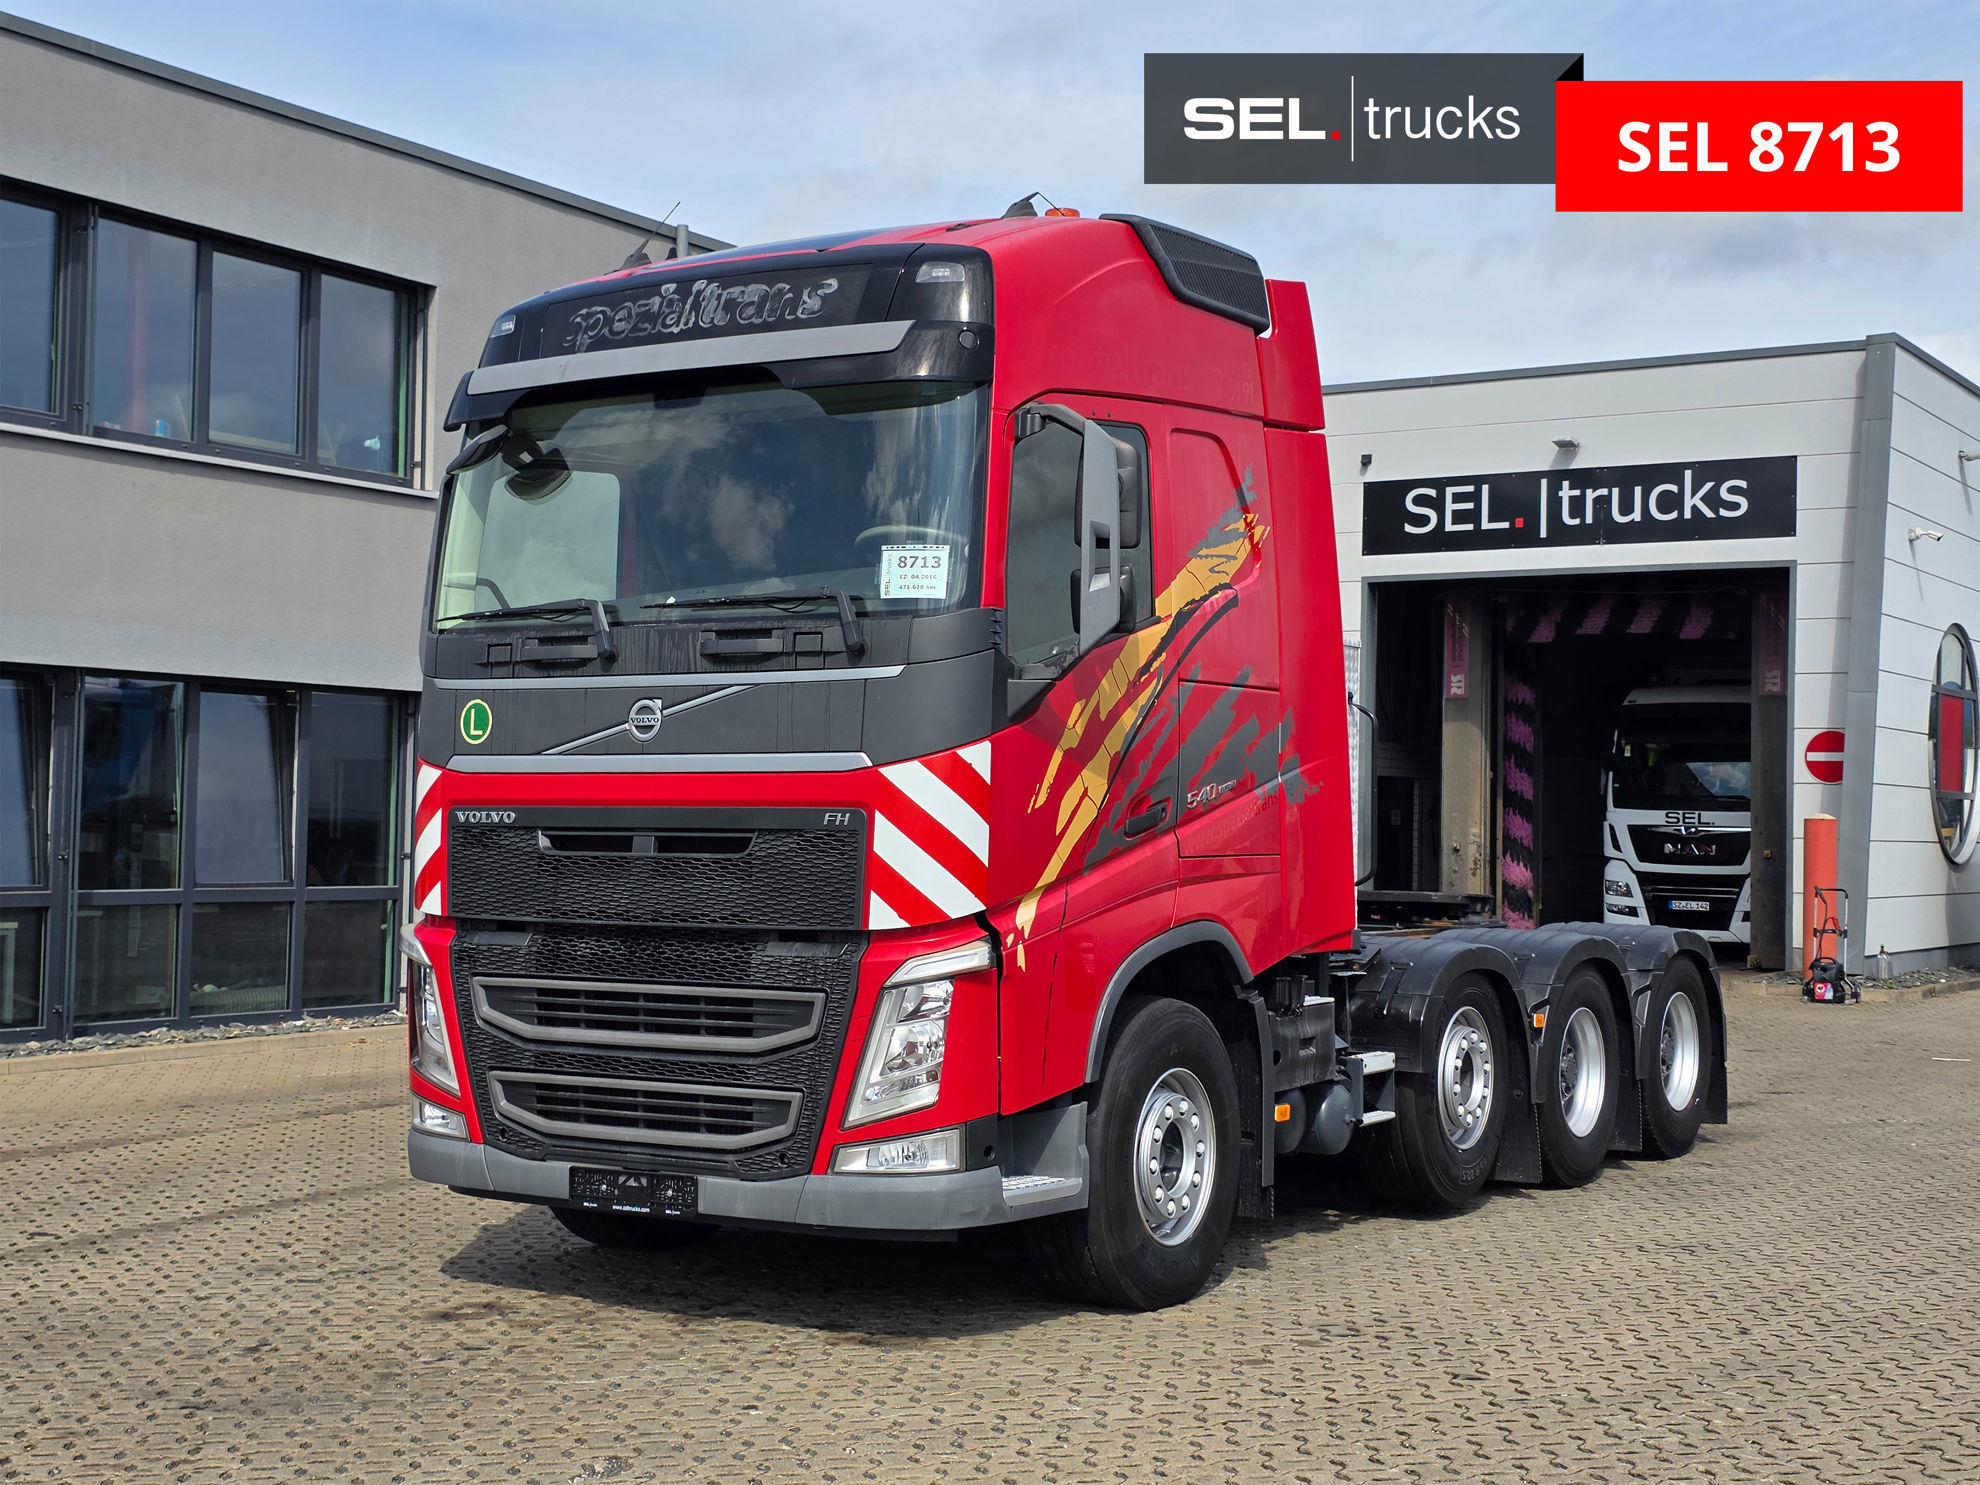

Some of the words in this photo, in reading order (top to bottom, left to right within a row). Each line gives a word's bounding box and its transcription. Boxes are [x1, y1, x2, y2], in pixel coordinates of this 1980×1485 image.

[1403, 482, 1524, 535] SEL.
[1558, 468, 1749, 527] trucks
[897, 555, 942, 569] 8713
[630, 716, 660, 724] VOLVO
[1186, 782, 1217, 809] 540
[455, 810, 516, 824] VOLVO
[823, 812, 850, 826] FH
[1665, 811, 1715, 825] SEL.
[1664, 843, 1716, 855] MAN
